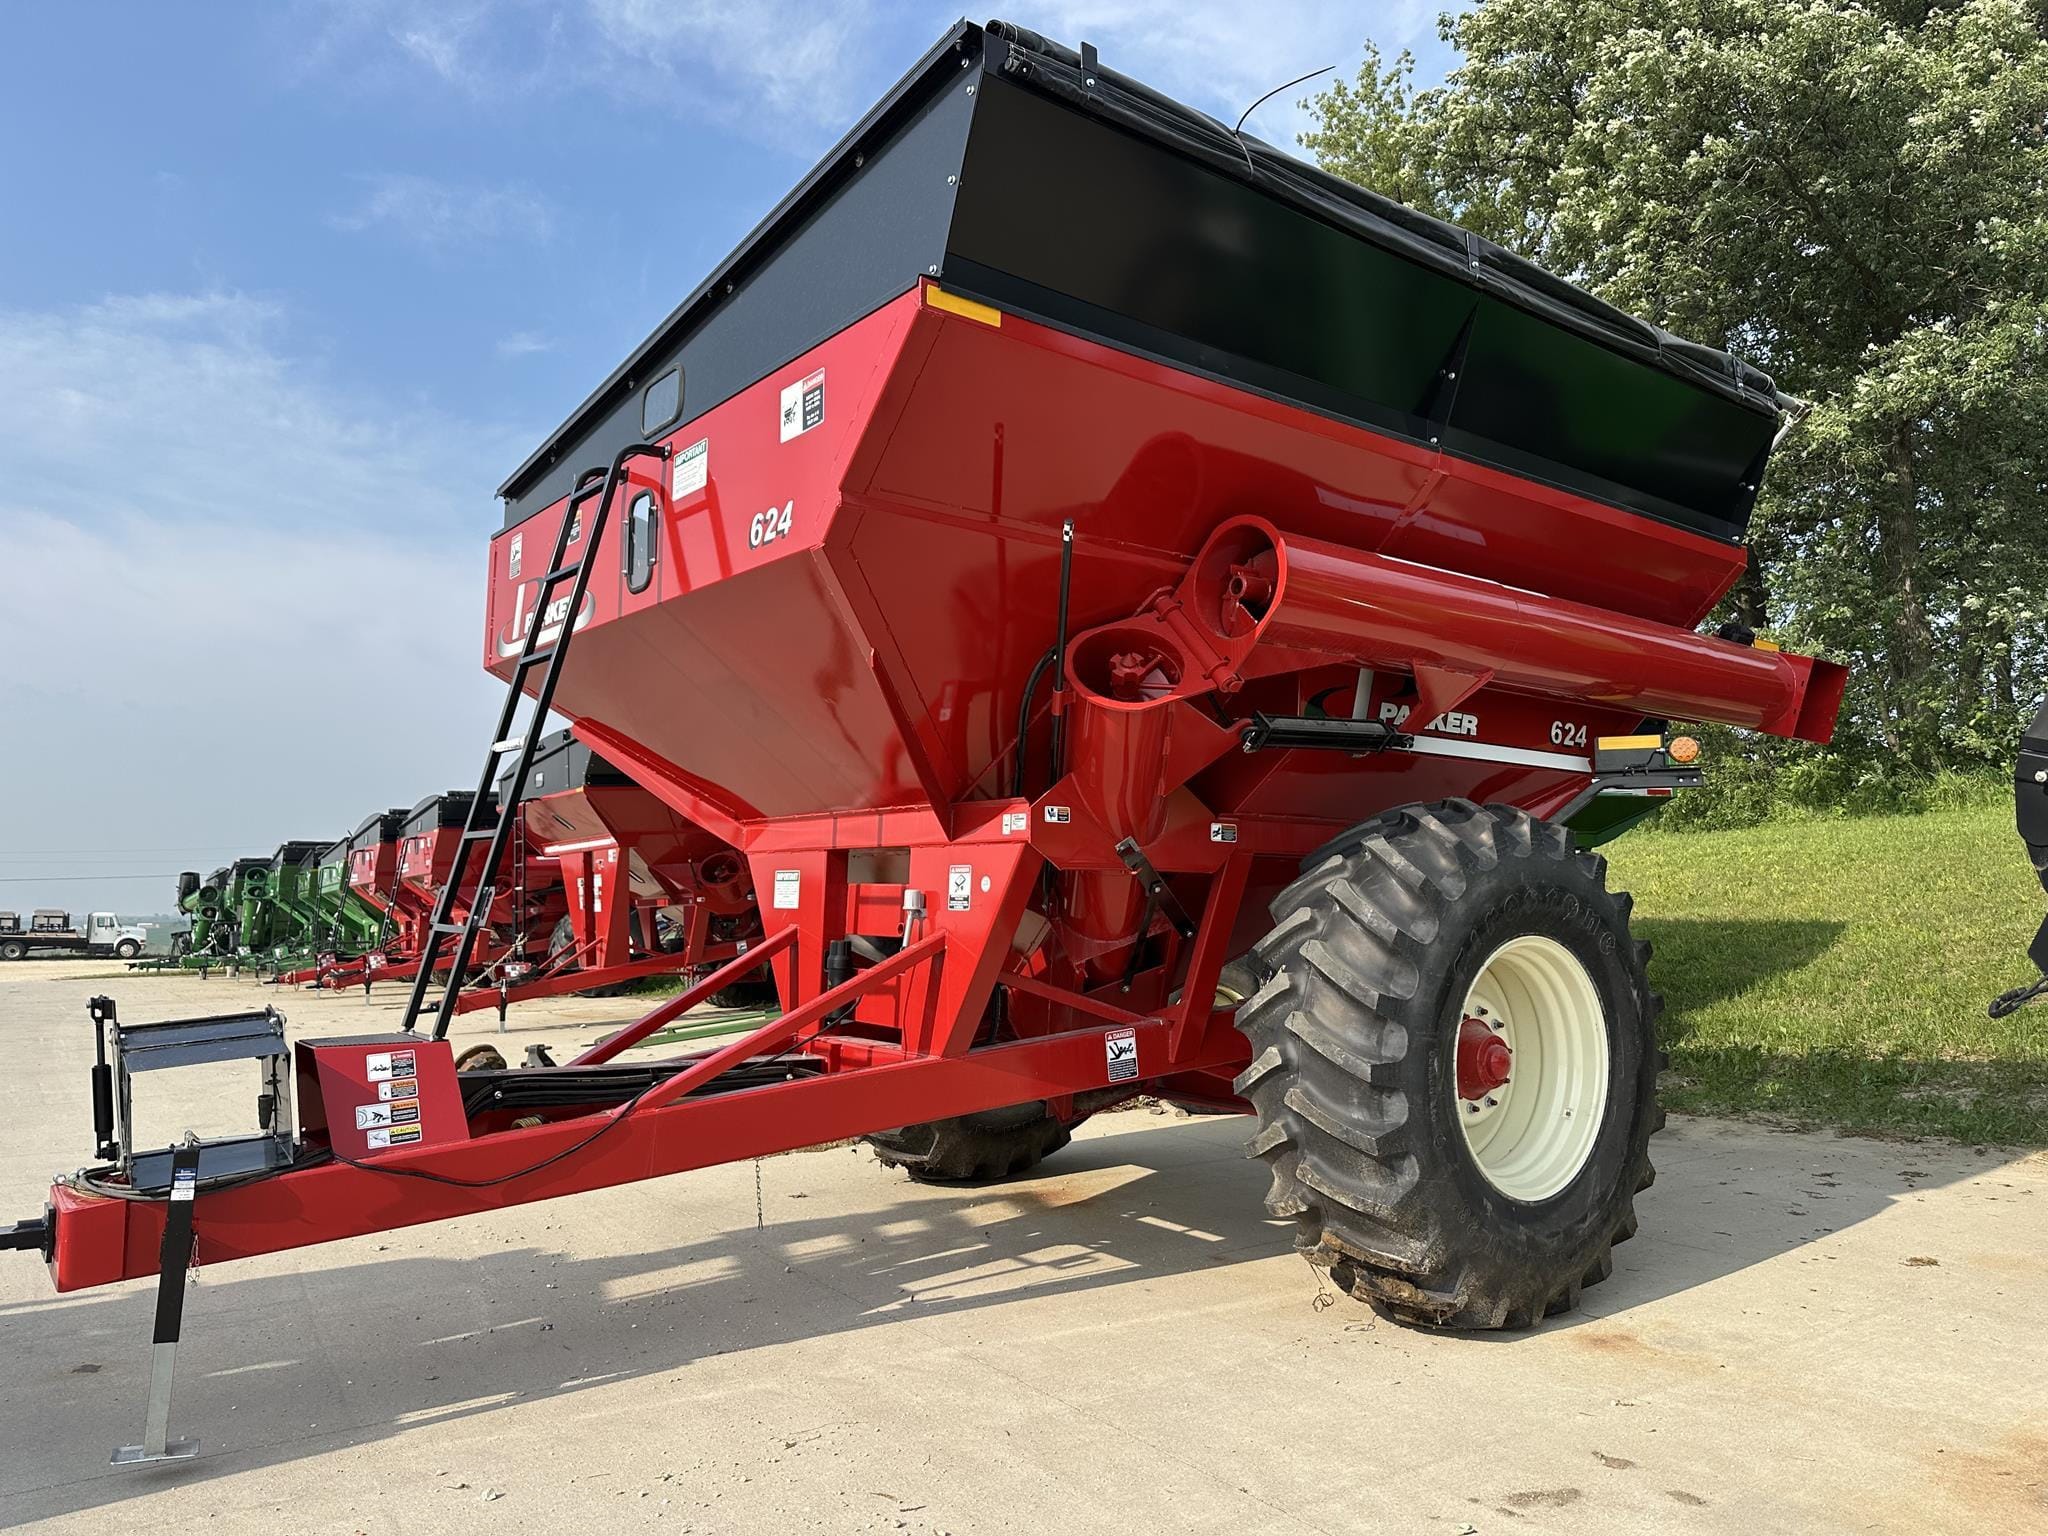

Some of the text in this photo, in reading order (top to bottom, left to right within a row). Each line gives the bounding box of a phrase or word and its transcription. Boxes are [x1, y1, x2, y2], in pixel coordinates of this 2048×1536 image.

[750, 500, 793, 547] 624
[1380, 702, 1478, 736] PAKER
[1551, 721, 1587, 748] 624
[396, 1125, 419, 1134] CAUTION
